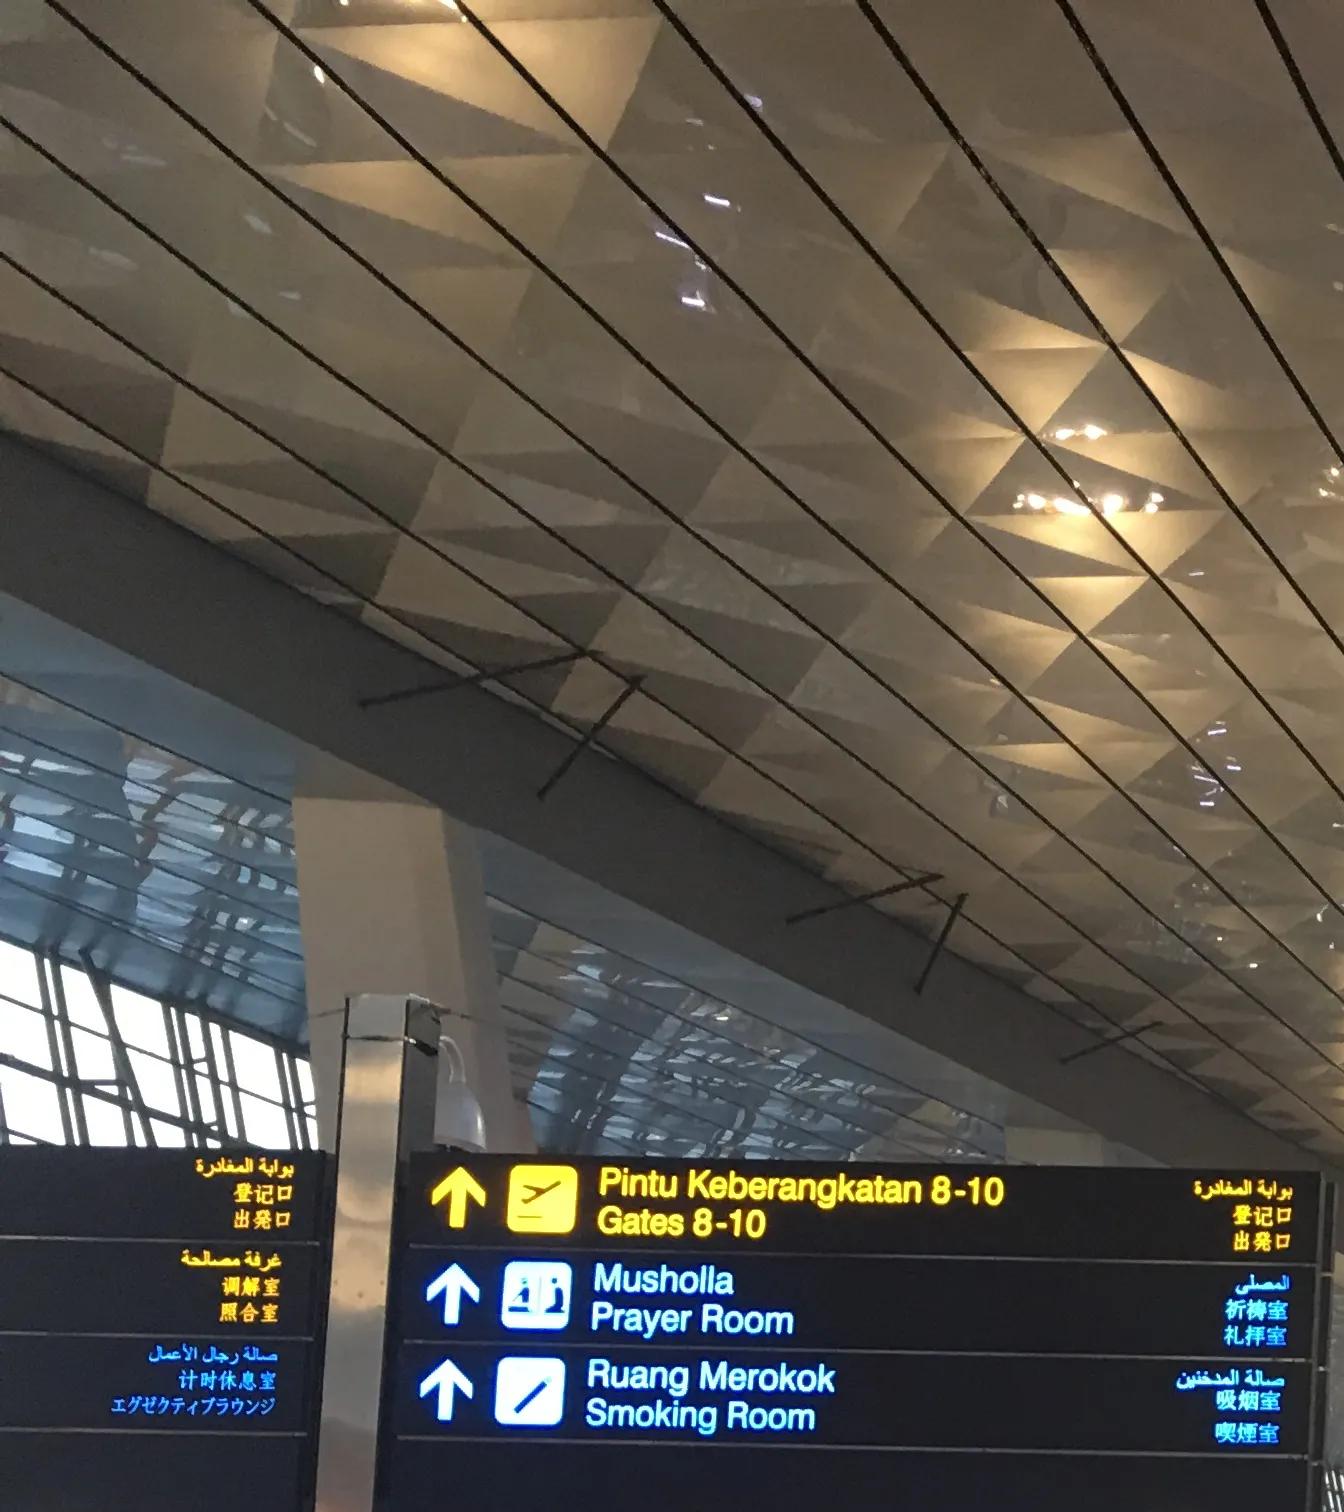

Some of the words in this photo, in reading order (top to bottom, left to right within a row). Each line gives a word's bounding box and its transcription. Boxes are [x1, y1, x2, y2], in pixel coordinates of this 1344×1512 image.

[195, 1157, 254, 1178] المغادرة
[258, 1157, 295, 1178] بوابة
[233, 1183, 293, 1205] 登记口
[599, 1167, 678, 1200] Pintu
[687, 1169, 922, 1209] Keberangkatan
[931, 1176, 1005, 1207] 8-10
[1194, 1179, 1252, 1201] المغادرة
[1257, 1178, 1293, 1201] بوابة
[233, 1209, 292, 1231] 出発口
[597, 1207, 685, 1237] Gates
[692, 1208, 767, 1239] 8-10
[1232, 1205, 1292, 1227] 登记口
[1232, 1230, 1291, 1252] 出発口
[180, 1250, 241, 1268] مصالحة
[244, 1250, 283, 1272] غرفة
[221, 1276, 281, 1298] 调解室
[593, 1263, 735, 1295] Musholla
[219, 1302, 279, 1323] 照合室
[591, 1302, 692, 1340] Prayer
[701, 1304, 795, 1335] Room
[1225, 1299, 1289, 1322] 祈祷室
[244, 1344, 278, 1363] صالة
[178, 1369, 277, 1392] 计时休息室
[587, 1358, 689, 1397] Ruang
[699, 1362, 837, 1393] Merokok
[1244, 1369, 1285, 1388] صالة
[1216, 1389, 1281, 1411] 吸烟室
[586, 1398, 718, 1436] Smoking
[727, 1401, 816, 1431] Room
